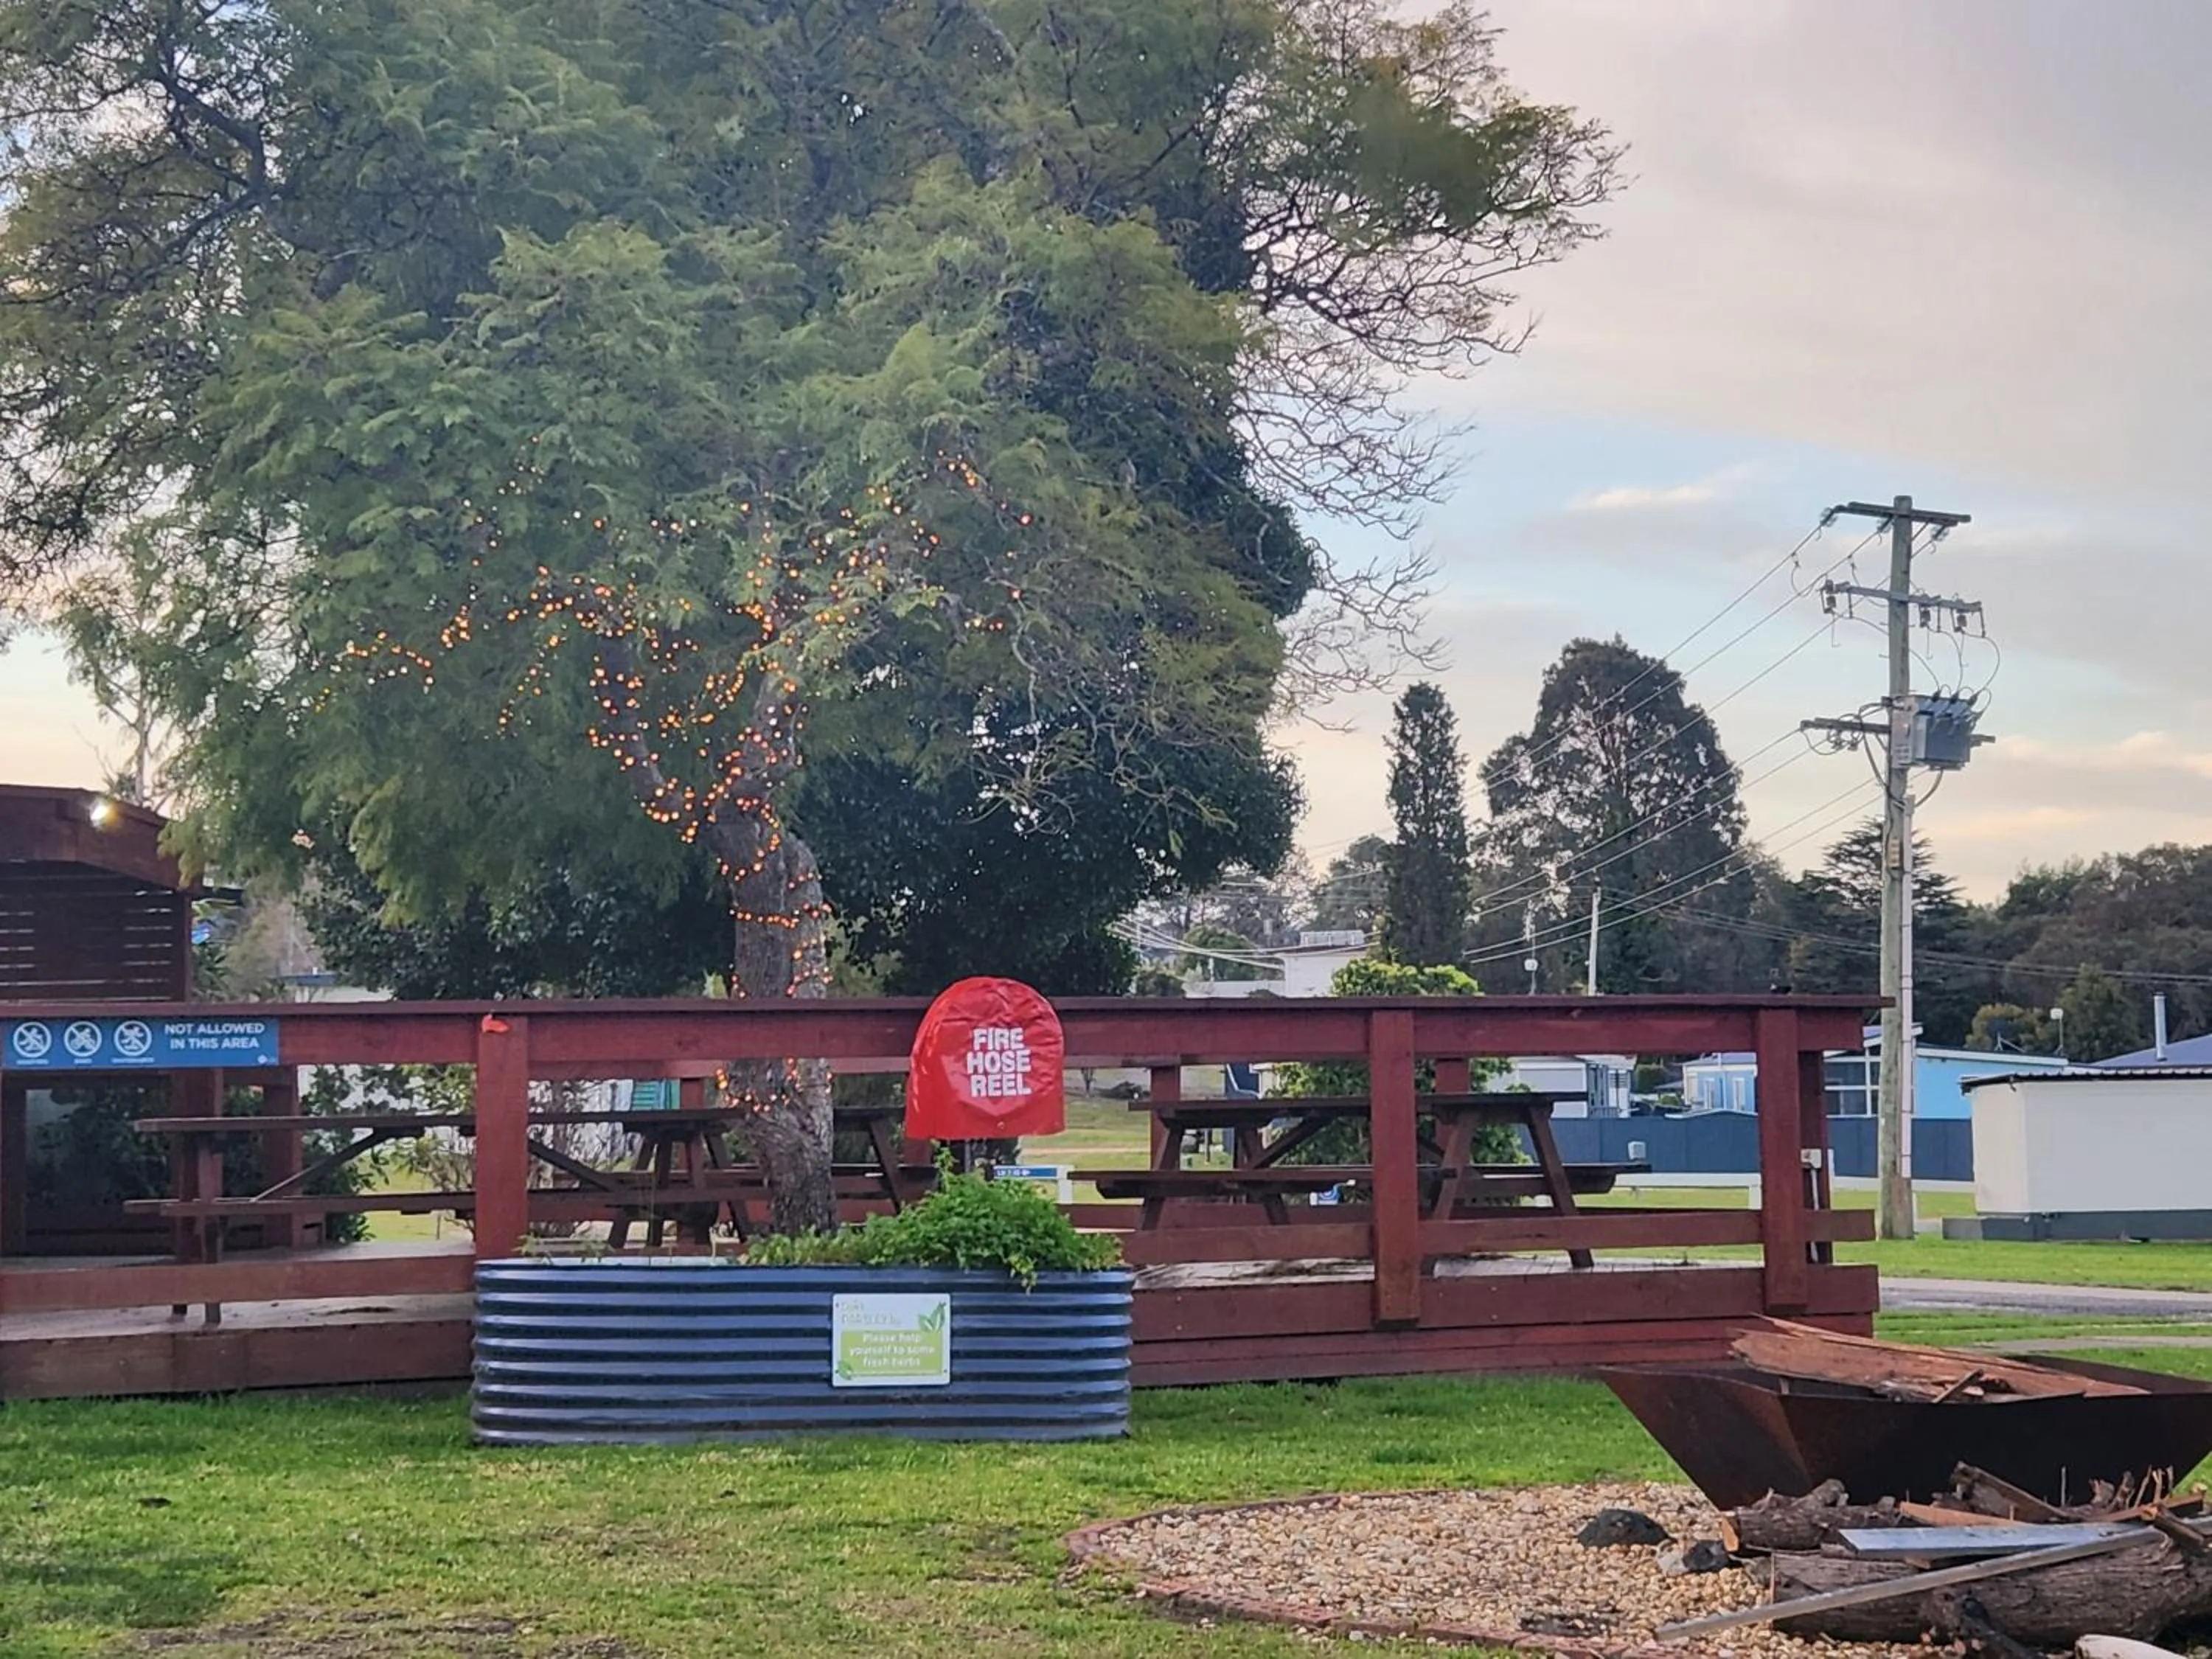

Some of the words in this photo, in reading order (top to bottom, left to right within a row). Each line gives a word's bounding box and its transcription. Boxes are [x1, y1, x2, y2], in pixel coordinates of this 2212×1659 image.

[164, 1023, 192, 1034] NOT
[198, 1023, 265, 1034] ALLOWED
[170, 1039, 185, 1050] IN
[189, 1038, 218, 1049] THIS
[221, 1038, 260, 1049] AREA
[973, 1028, 1024, 1050] FIRE
[967, 1049, 1032, 1074] HOSE
[970, 1074, 1032, 1097] REEL
[863, 1332, 897, 1343] Please
[898, 1332, 922, 1343] help
[849, 1343, 891, 1357] yourself
[893, 1346, 905, 1354] to
[907, 1346, 935, 1355] some
[863, 1357, 889, 1367] fresh
[891, 1357, 921, 1367] herbs
